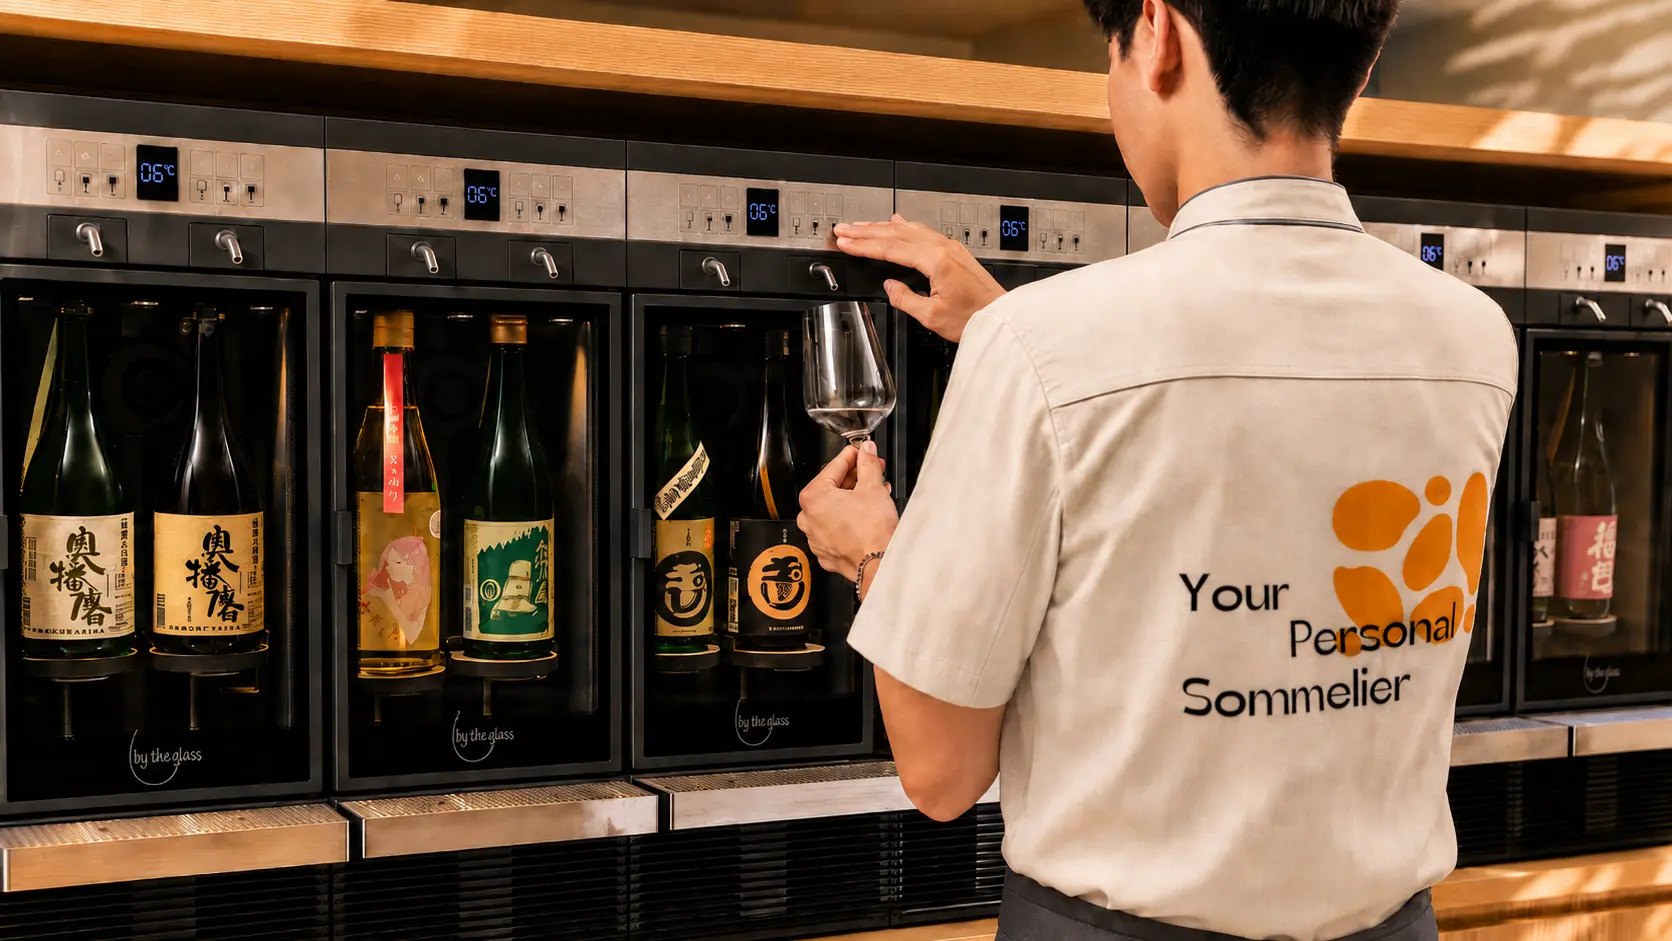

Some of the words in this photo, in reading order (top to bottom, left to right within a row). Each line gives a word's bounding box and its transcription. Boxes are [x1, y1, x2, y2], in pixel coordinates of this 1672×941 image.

[140, 162, 175, 183] 06°C
[1179, 573, 1289, 612] Your
[1290, 601, 1457, 658] Personal
[1182, 667, 1411, 717] Sommelier
[738, 715, 750, 732] by
[751, 715, 766, 727] the
[766, 713, 790, 731] glass
[455, 728, 468, 748] by
[469, 727, 487, 742] the
[488, 727, 515, 745] glass
[133, 748, 148, 769] by
[151, 747, 171, 763] the
[172, 747, 202, 767] glass
